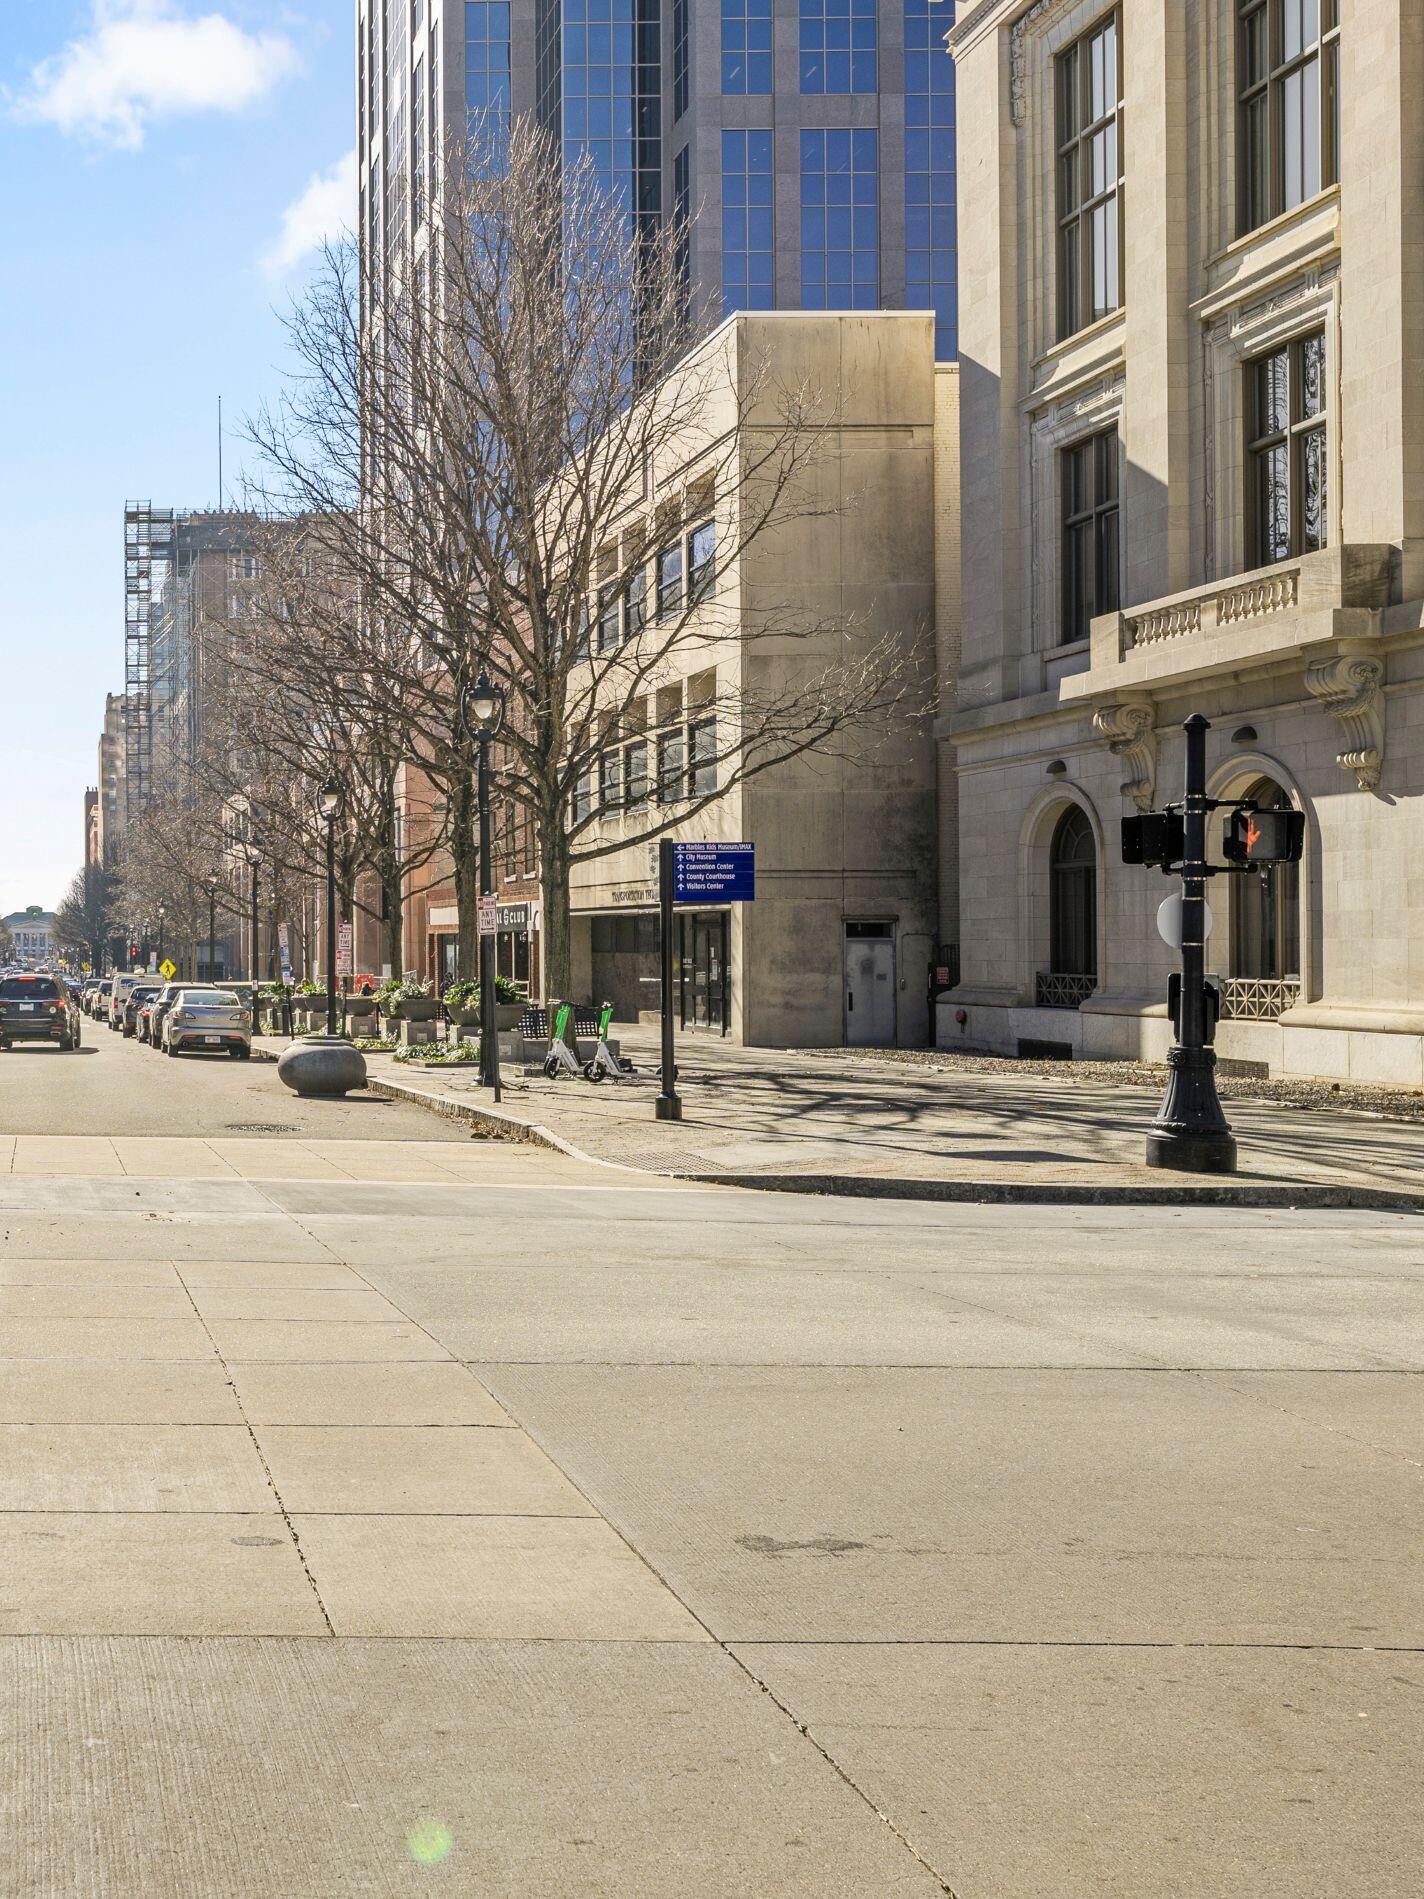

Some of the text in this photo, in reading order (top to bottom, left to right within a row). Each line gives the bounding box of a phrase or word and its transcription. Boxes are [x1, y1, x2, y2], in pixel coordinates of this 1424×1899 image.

[686, 873, 704, 881] County
[481, 911, 493, 919] ANY
[509, 911, 525, 924] CLUB
